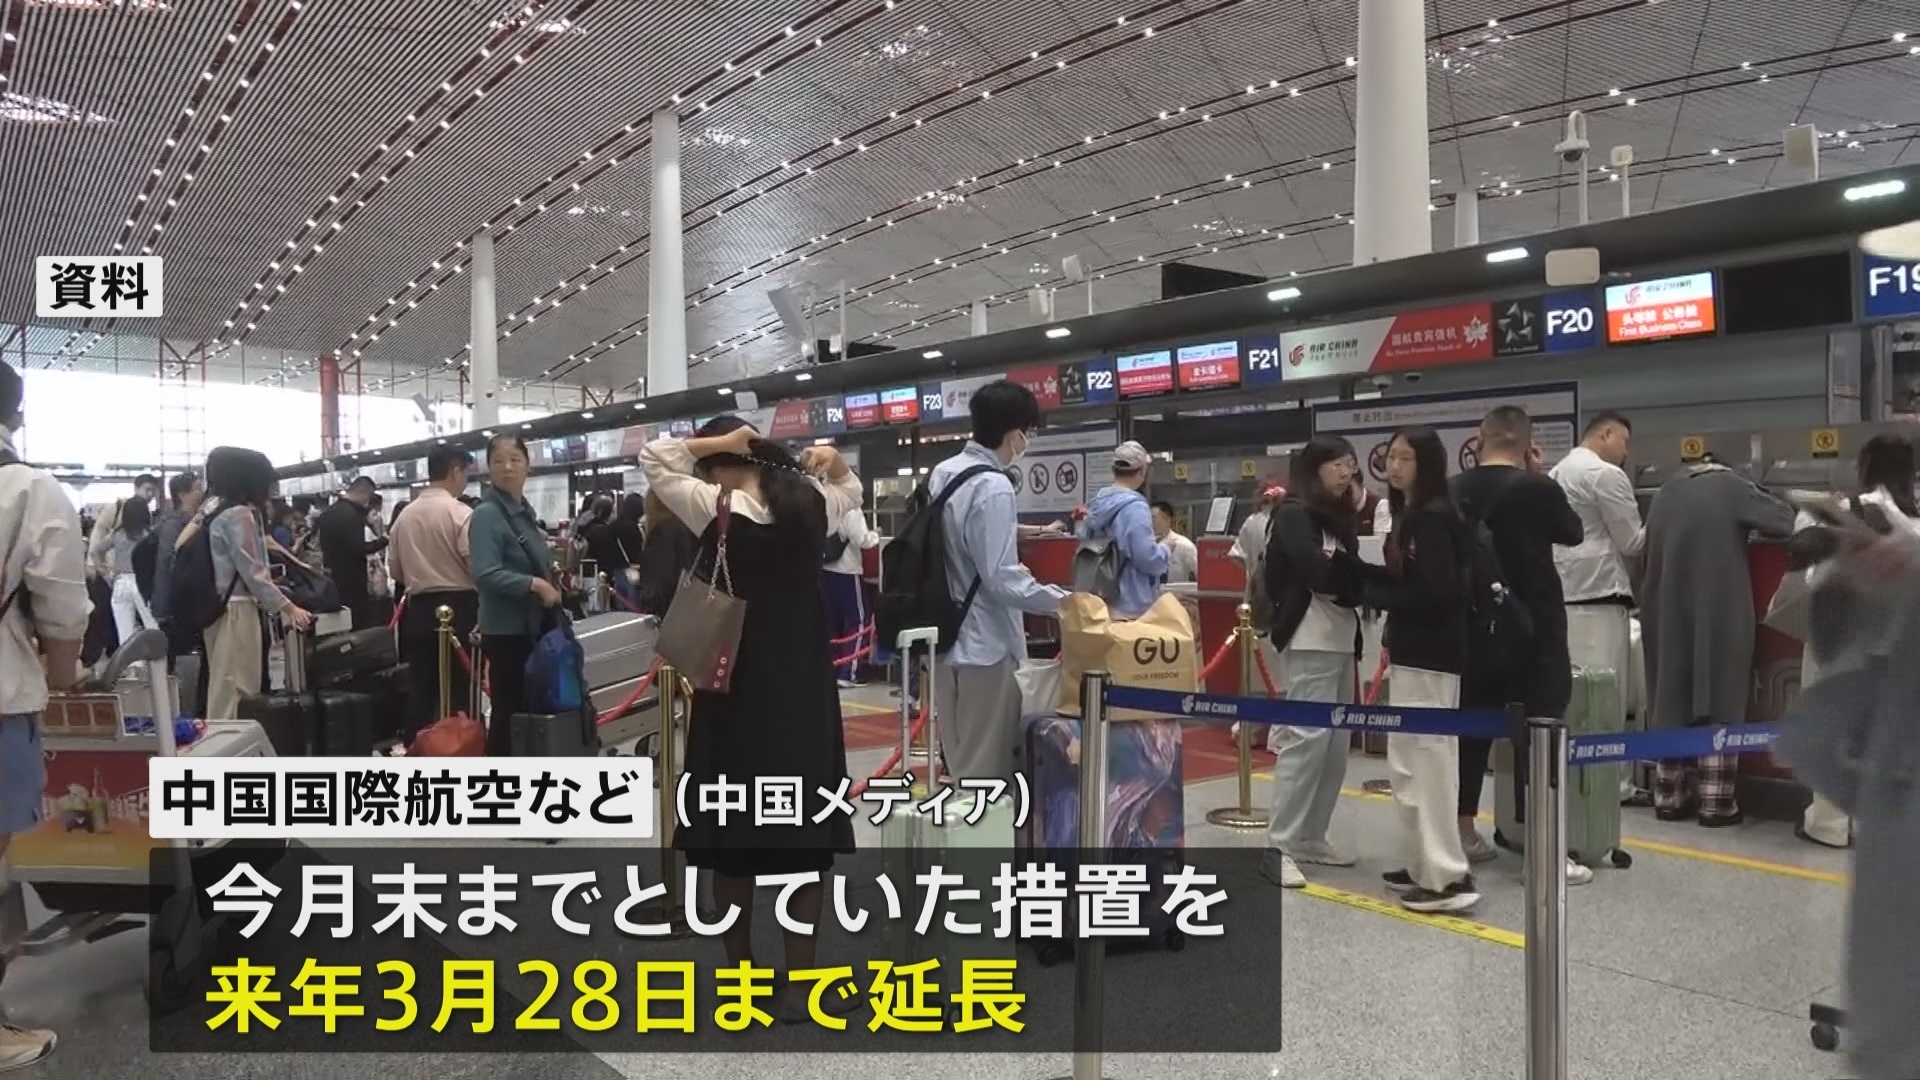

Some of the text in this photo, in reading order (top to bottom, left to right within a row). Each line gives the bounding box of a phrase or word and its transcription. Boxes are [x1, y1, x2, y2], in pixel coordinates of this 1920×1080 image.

[1869, 263, 1920, 297] F19
[1547, 307, 1593, 336] F20
[1309, 339, 1358, 353] AIR CHINA
[1249, 347, 1278, 370] F21
[1086, 371, 1113, 391] F22
[923, 394, 943, 411] F23
[826, 407, 844, 423] F24
[1133, 637, 1180, 666] GU
[1195, 701, 1238, 714] AIR CHINA
[1346, 708, 1402, 727] AIR CHINA
[1726, 734, 1742, 746] AIR
[1576, 743, 1626, 759] AIR CHINA
